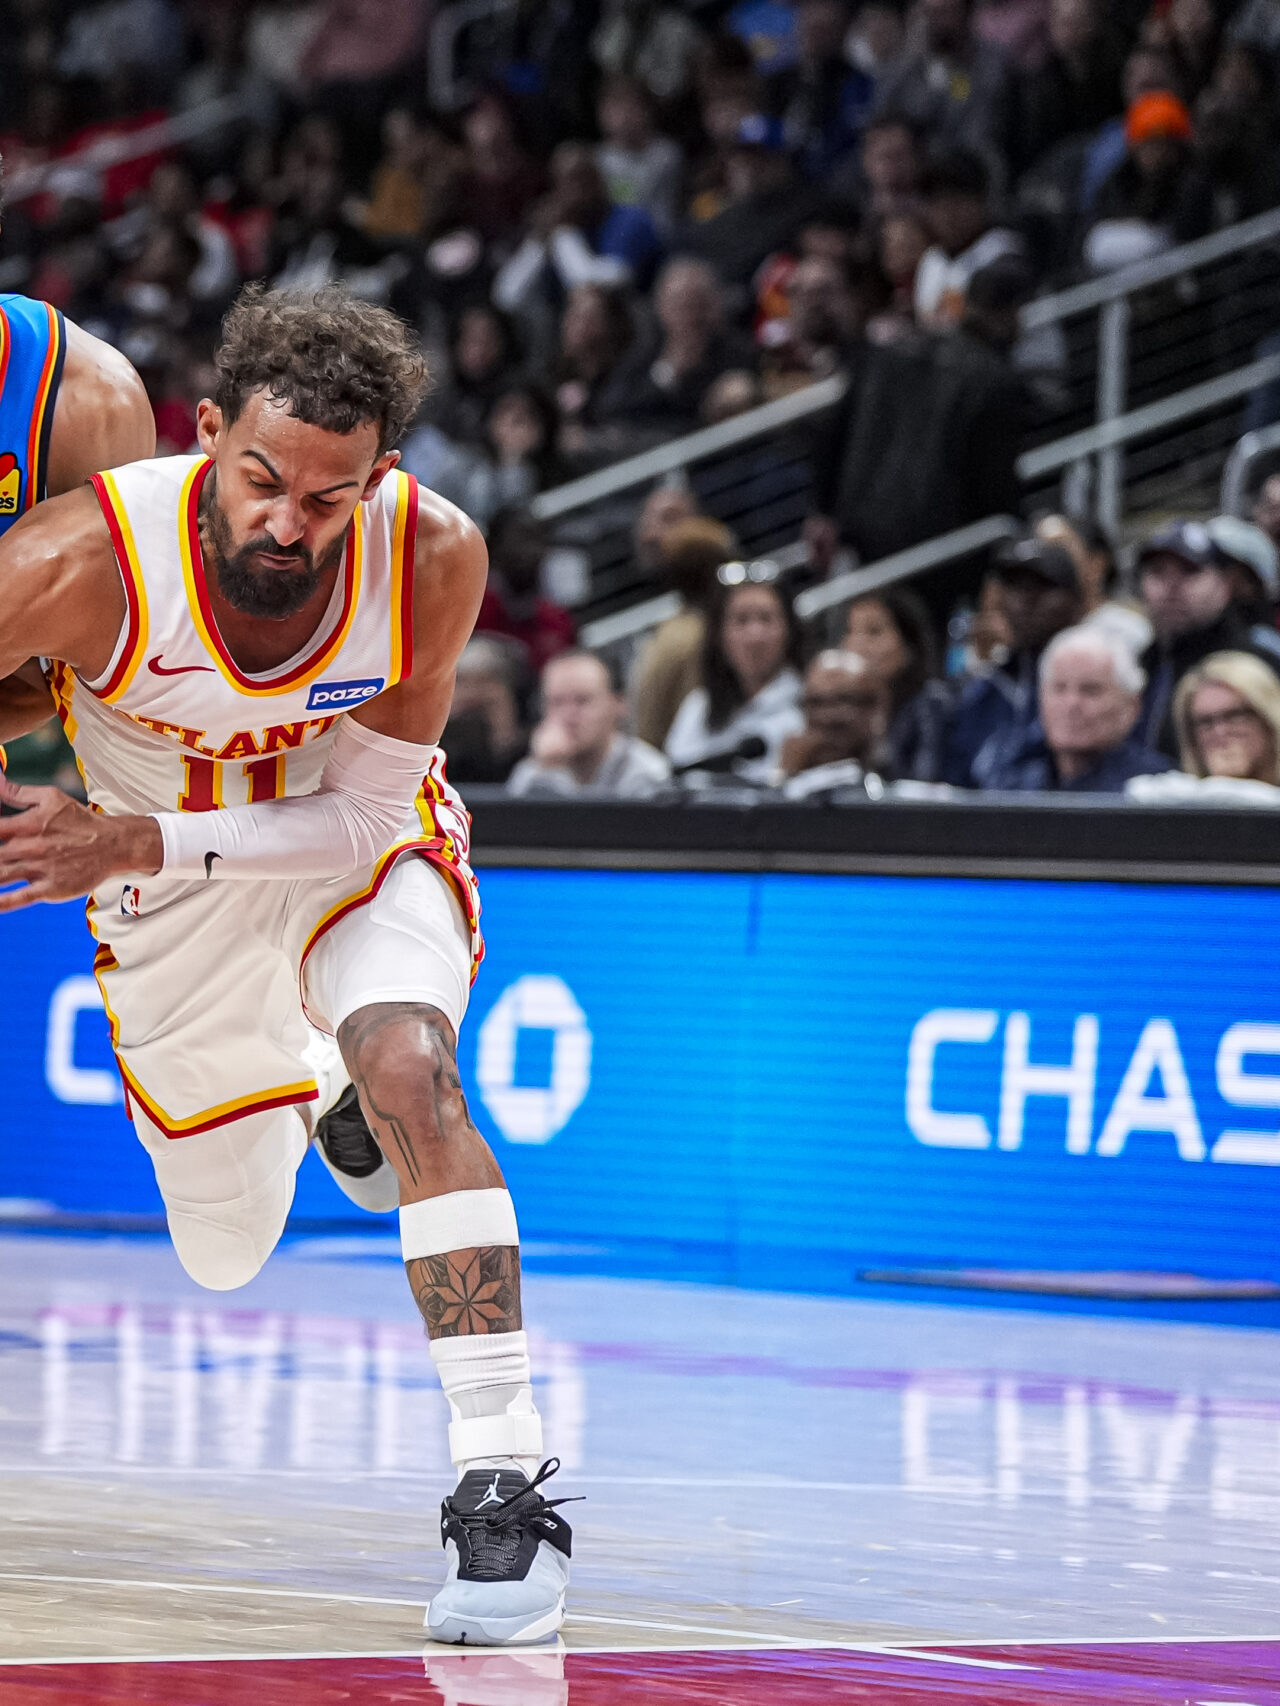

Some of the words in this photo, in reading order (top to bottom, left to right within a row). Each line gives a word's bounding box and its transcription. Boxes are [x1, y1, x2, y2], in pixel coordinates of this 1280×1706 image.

[311, 685, 378, 706] paze
[124, 712, 343, 760] TLANT
[177, 752, 287, 813] 11
